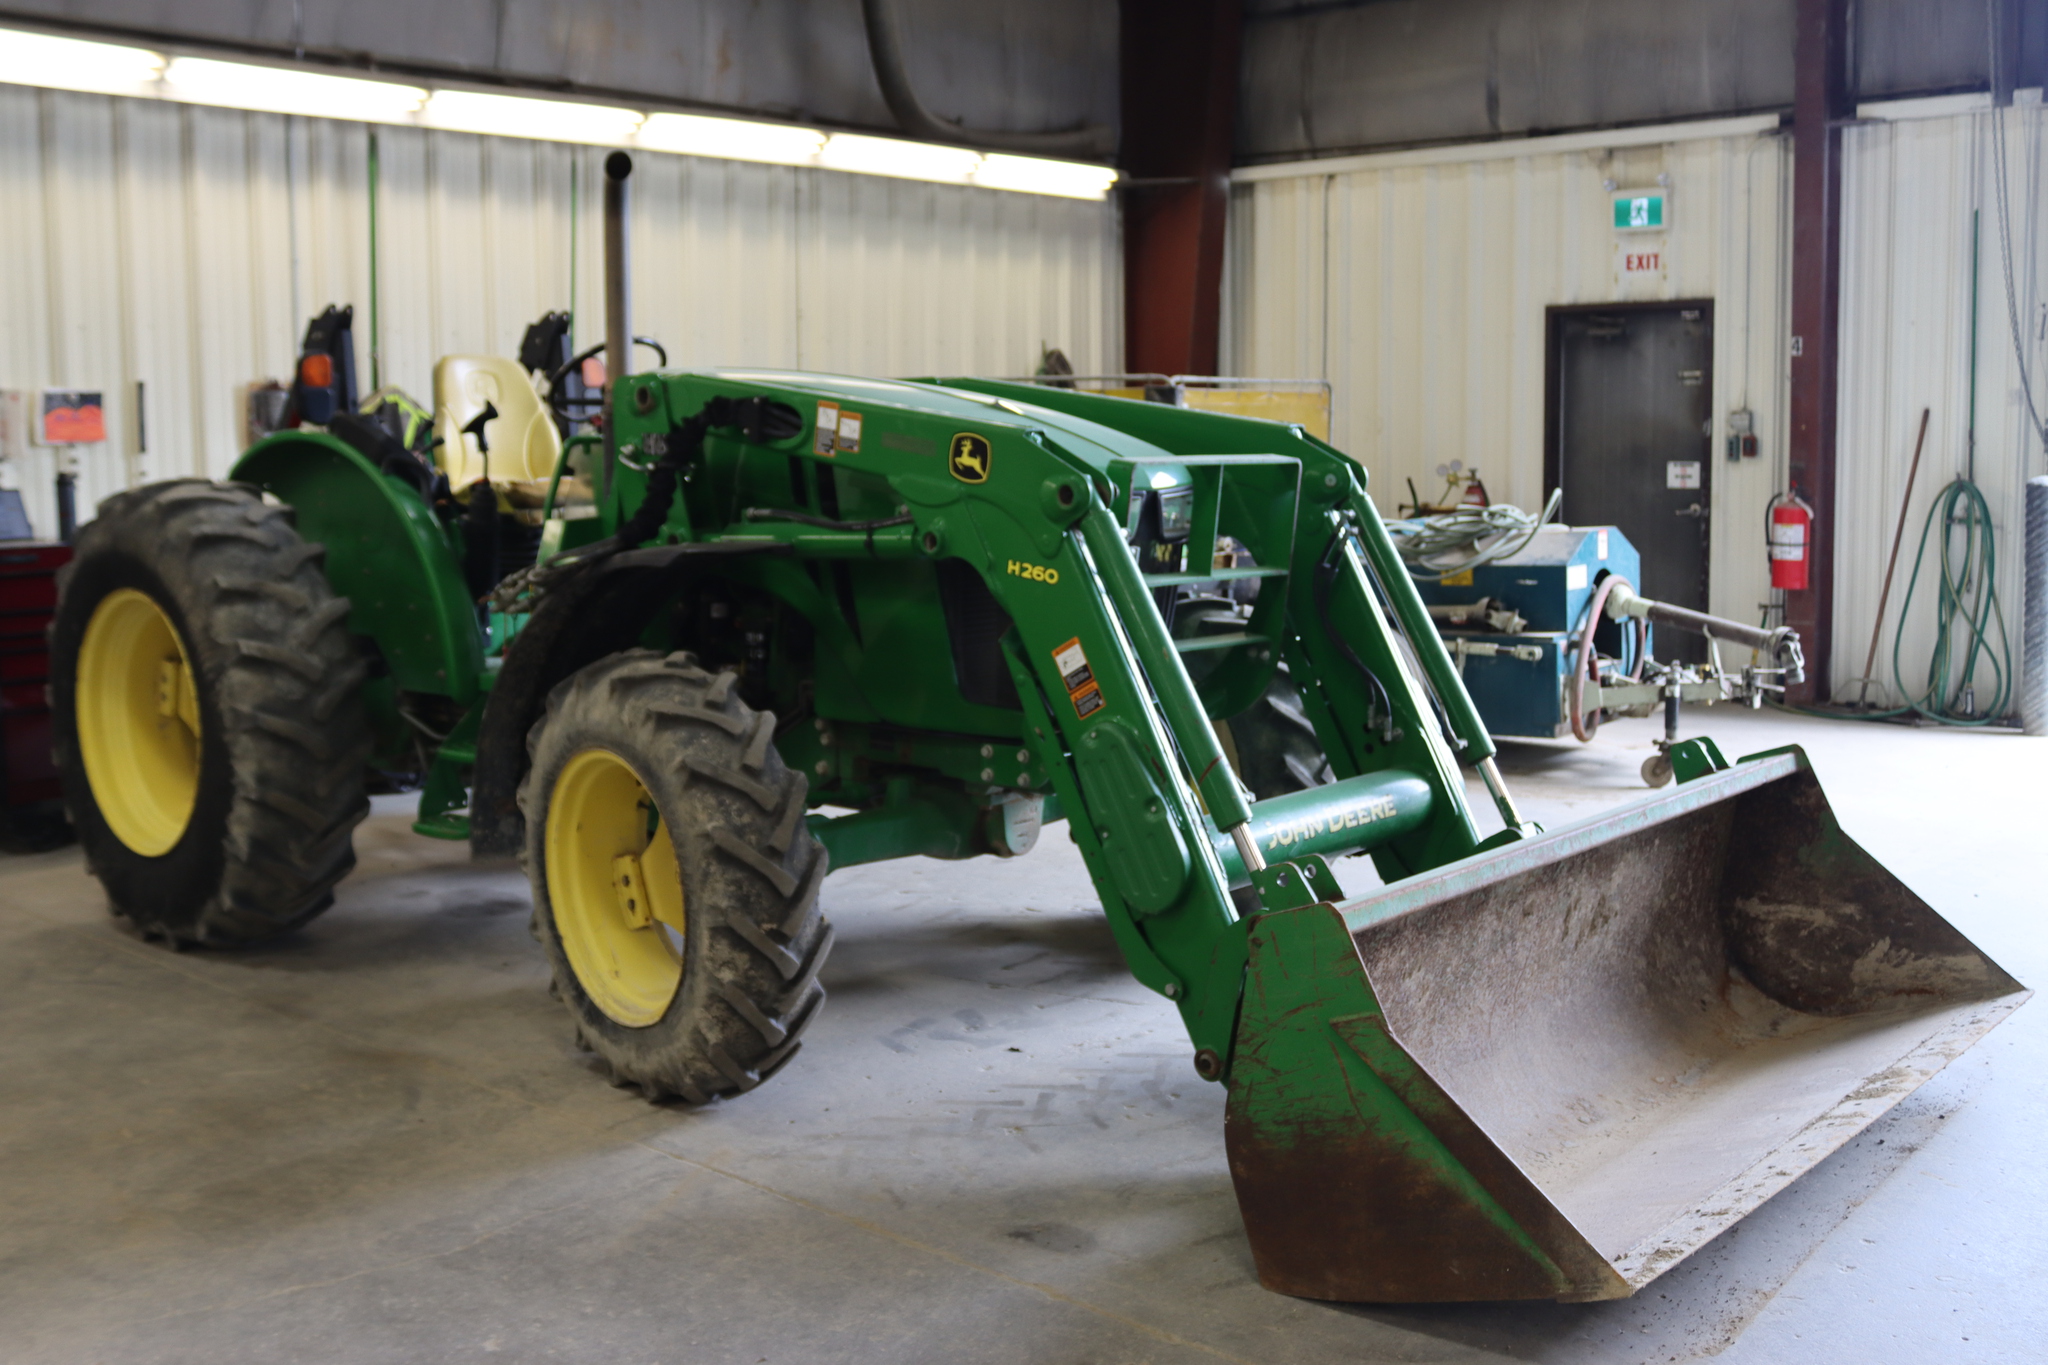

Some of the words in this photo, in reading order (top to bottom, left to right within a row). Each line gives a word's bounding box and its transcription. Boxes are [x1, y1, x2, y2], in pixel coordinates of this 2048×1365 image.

[1625, 252, 1660, 271] EXIT
[1006, 559, 1060, 585] H260
[1265, 817, 1323, 850] JOHN
[1325, 794, 1397, 833] DEERE
